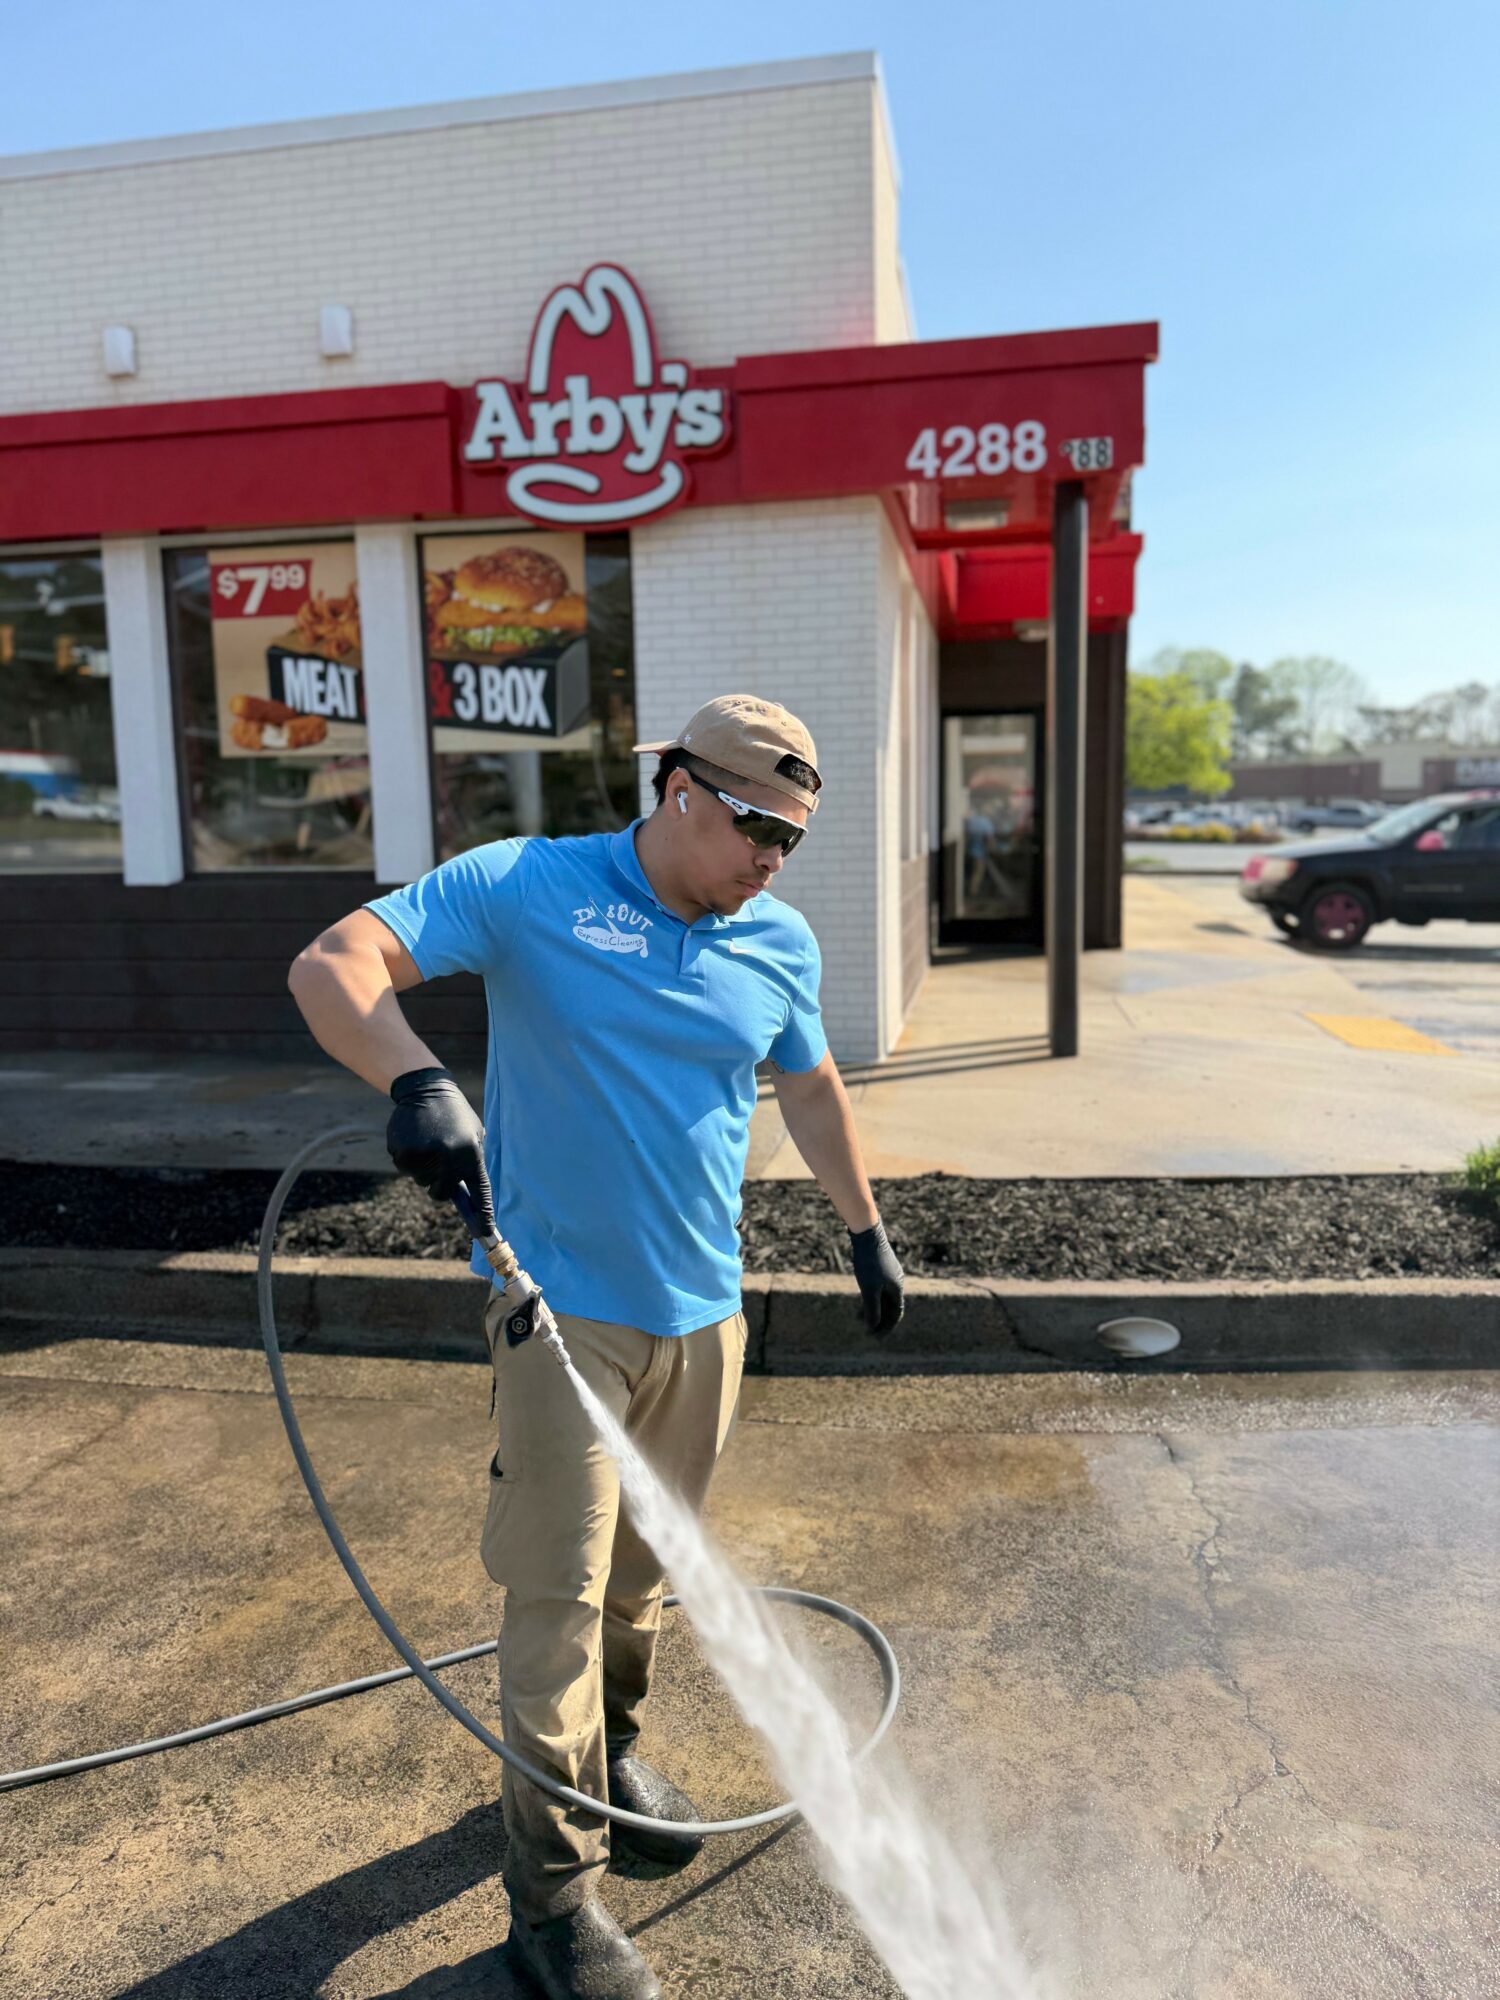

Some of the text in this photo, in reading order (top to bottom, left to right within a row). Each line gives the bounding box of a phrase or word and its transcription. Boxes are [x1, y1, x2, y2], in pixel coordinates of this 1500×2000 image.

[464, 364, 723, 474] Arby's
[906, 420, 1048, 479] 4288
[281, 657, 358, 719] MEAT
[479, 664, 552, 729] BOX
